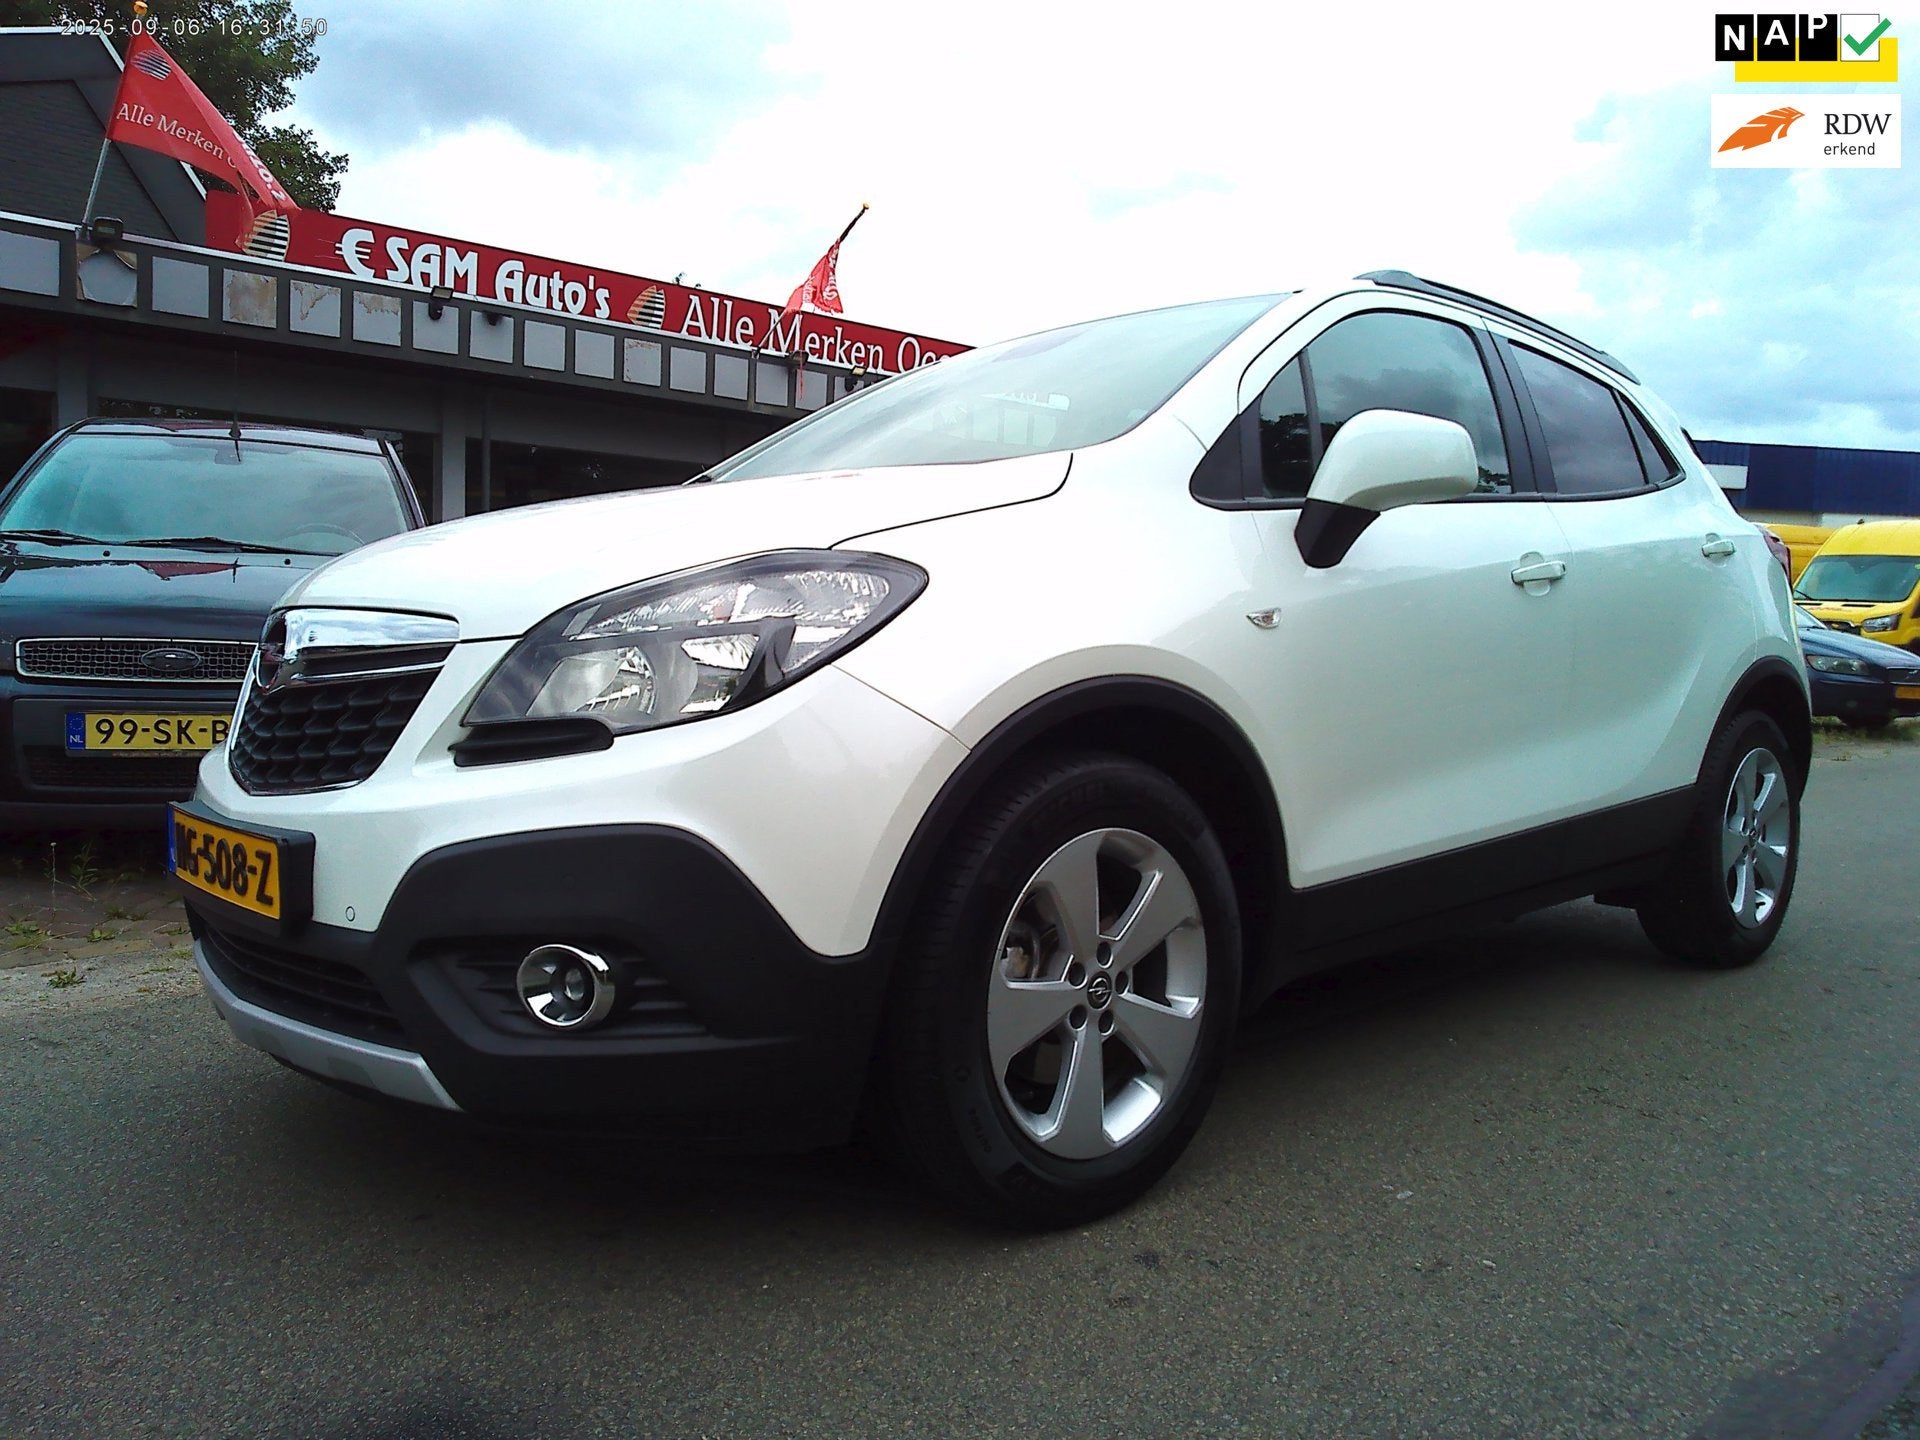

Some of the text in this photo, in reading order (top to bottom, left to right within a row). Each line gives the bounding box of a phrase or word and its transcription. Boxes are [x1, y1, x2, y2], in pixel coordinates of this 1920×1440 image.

[116, 102, 225, 161] Alle Merken
[385, 236, 479, 298] SAM
[494, 259, 611, 320] Auto's
[678, 293, 756, 347] Alle
[766, 306, 885, 375] Merken
[69, 734, 84, 744] NL
[94, 717, 230, 746] 99-SK-B
